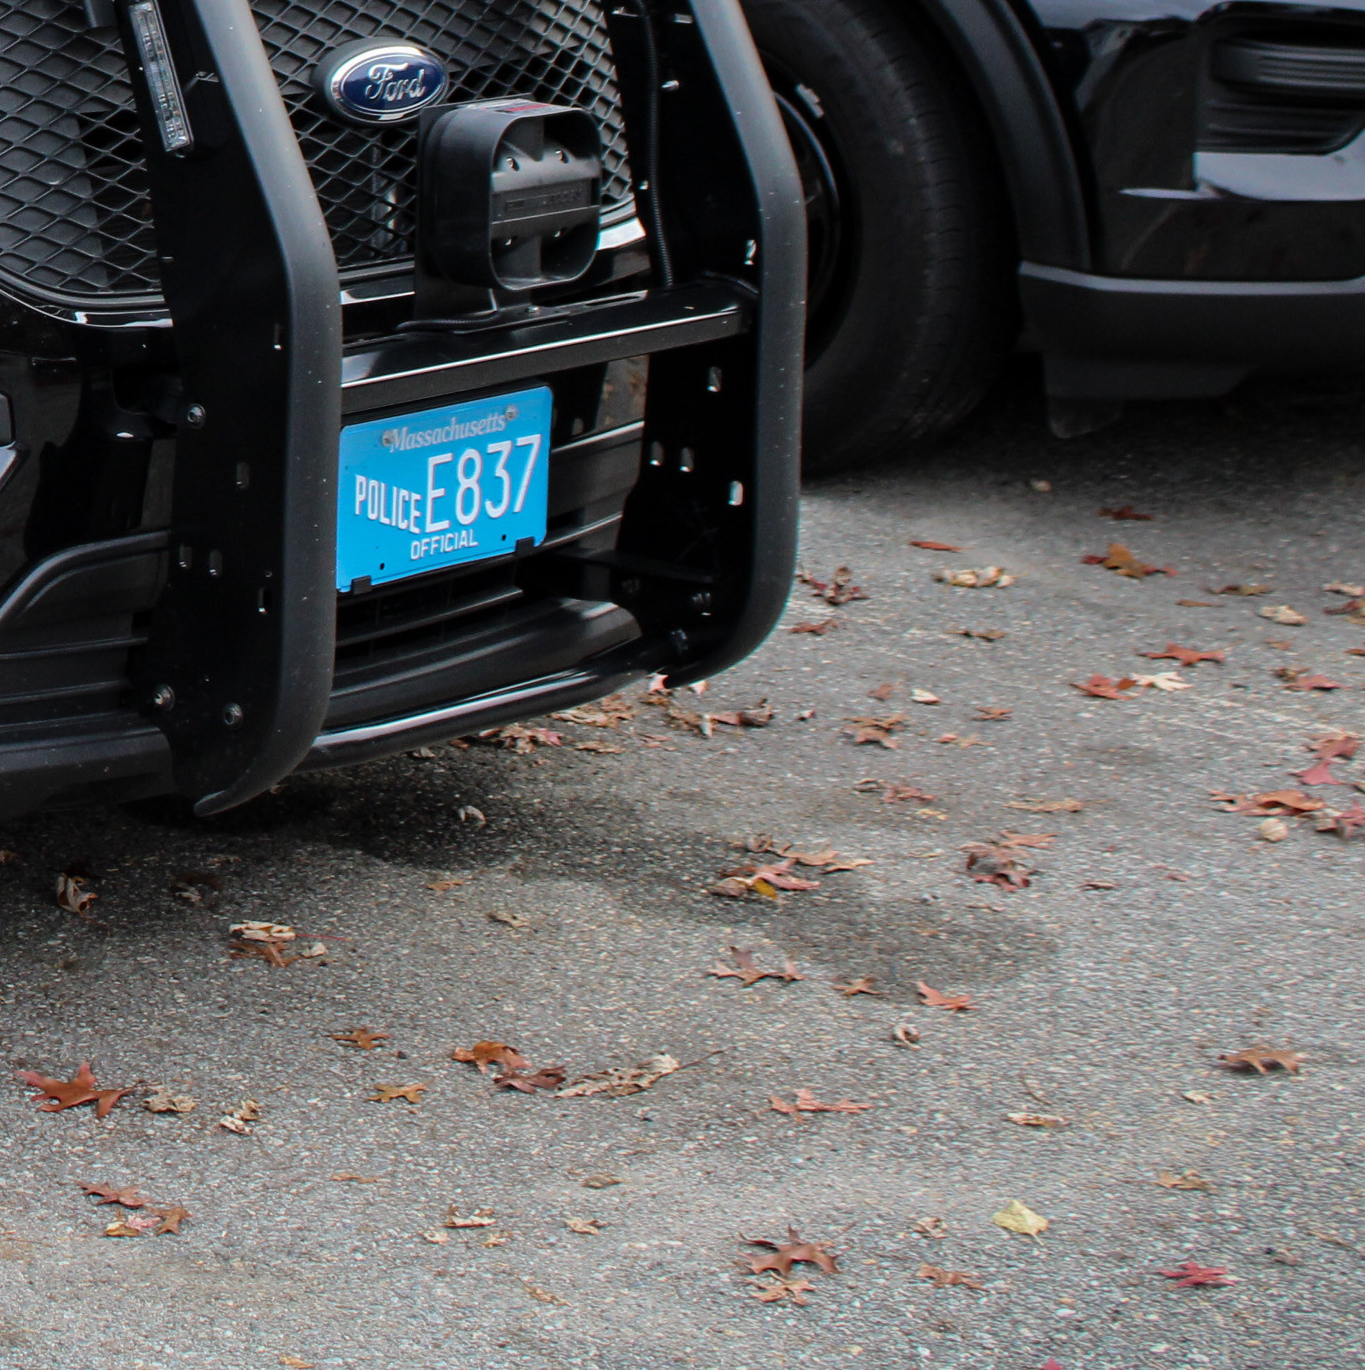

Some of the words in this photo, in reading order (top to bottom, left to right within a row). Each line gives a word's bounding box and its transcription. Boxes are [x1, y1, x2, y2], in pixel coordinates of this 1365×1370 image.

[365, 62, 426, 102] Ford
[389, 412, 507, 454] Massachusetts
[355, 474, 422, 535] POLICE
[424, 433, 542, 534] E837
[410, 528, 479, 561] OFFICIAL
